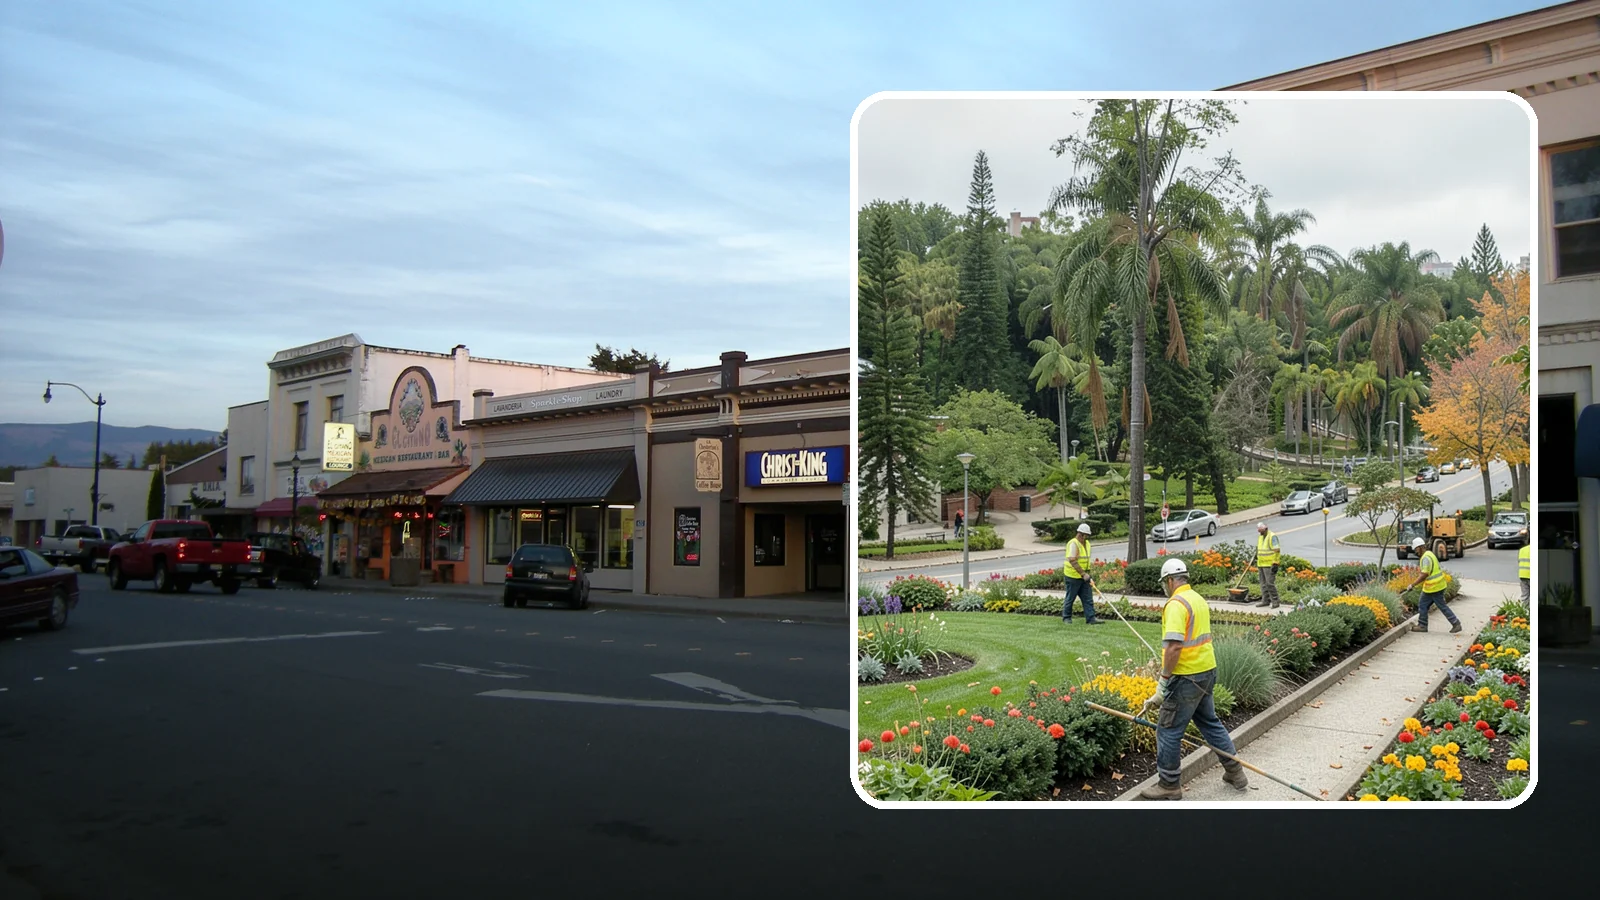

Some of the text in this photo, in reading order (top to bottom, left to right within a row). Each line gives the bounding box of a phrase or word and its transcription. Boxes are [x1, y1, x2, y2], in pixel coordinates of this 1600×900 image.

[595, 389, 623, 400] LAUNDRY
[493, 401, 523, 413] LAVANDERIA
[397, 452, 433, 462] RESTAURANT
[438, 450, 450, 459] BAR
[761, 452, 797, 478] CHRIST
[799, 450, 827, 476] KING
